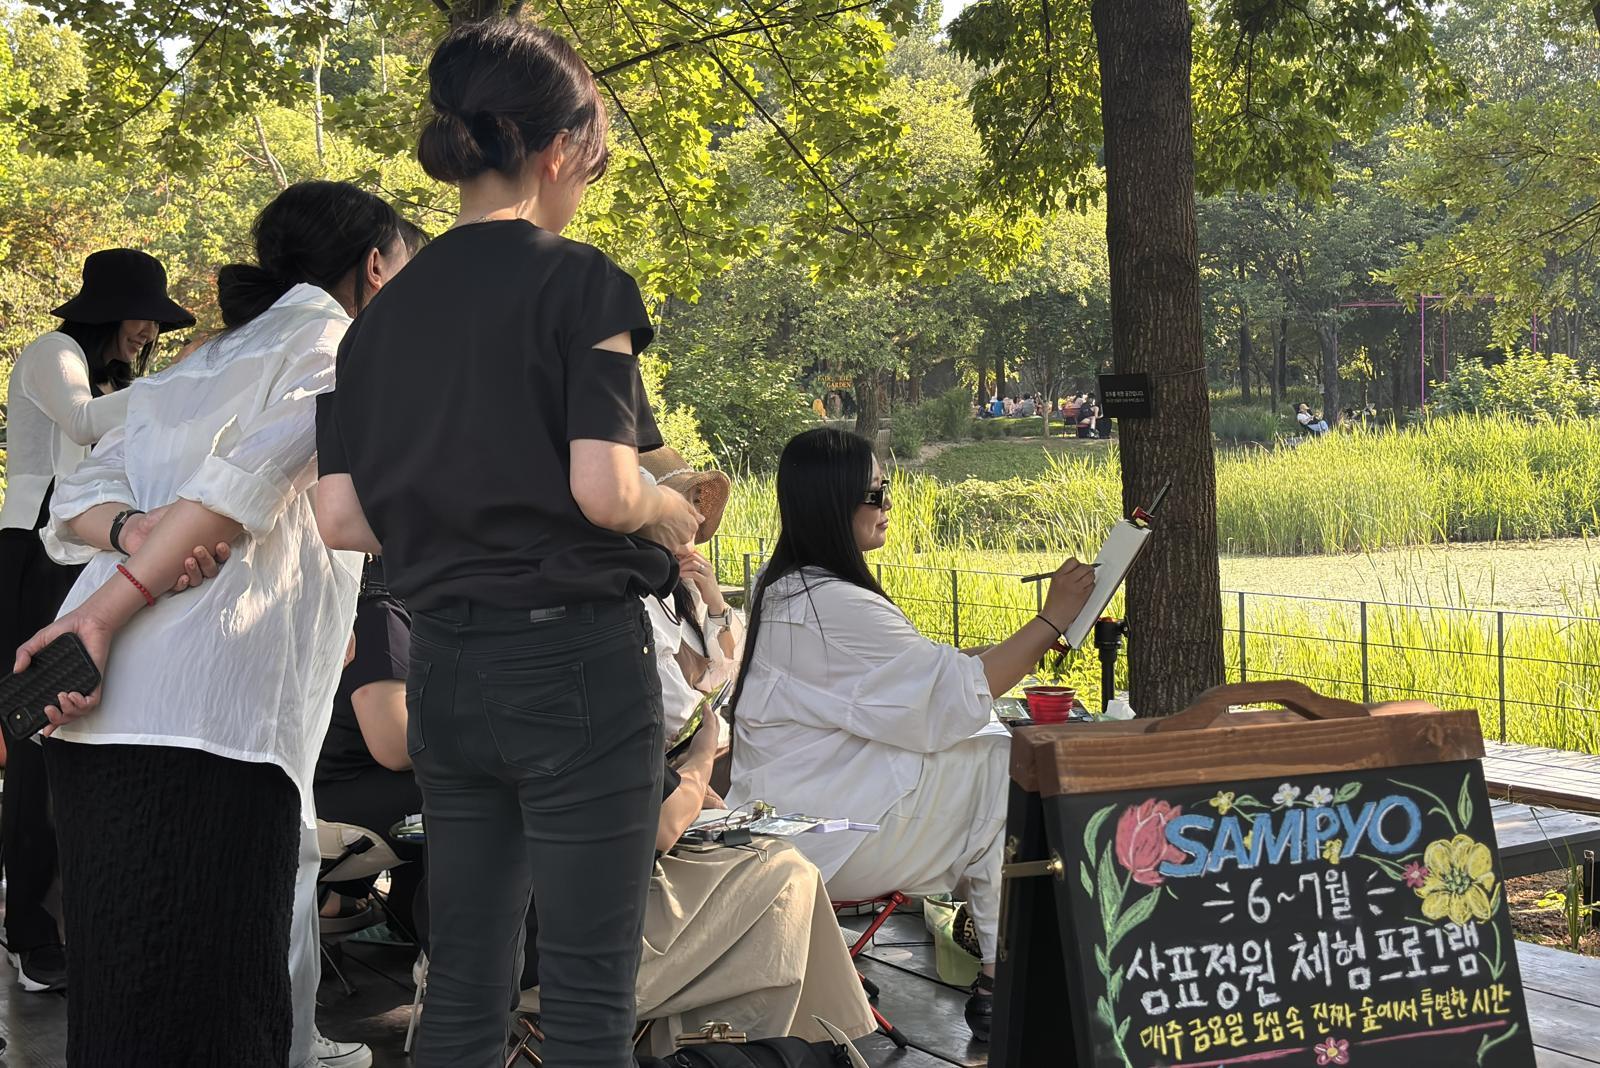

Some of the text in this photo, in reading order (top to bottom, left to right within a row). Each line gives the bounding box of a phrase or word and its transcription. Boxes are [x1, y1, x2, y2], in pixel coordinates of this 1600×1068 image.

[1159, 794, 1422, 878] SAMPYO
[1126, 919, 1480, 1015] 삼표정원 체험 프로그램
[1139, 983, 1512, 1061] 매주 금요일 도심 속 진짜 숲에서 특별한 시간
